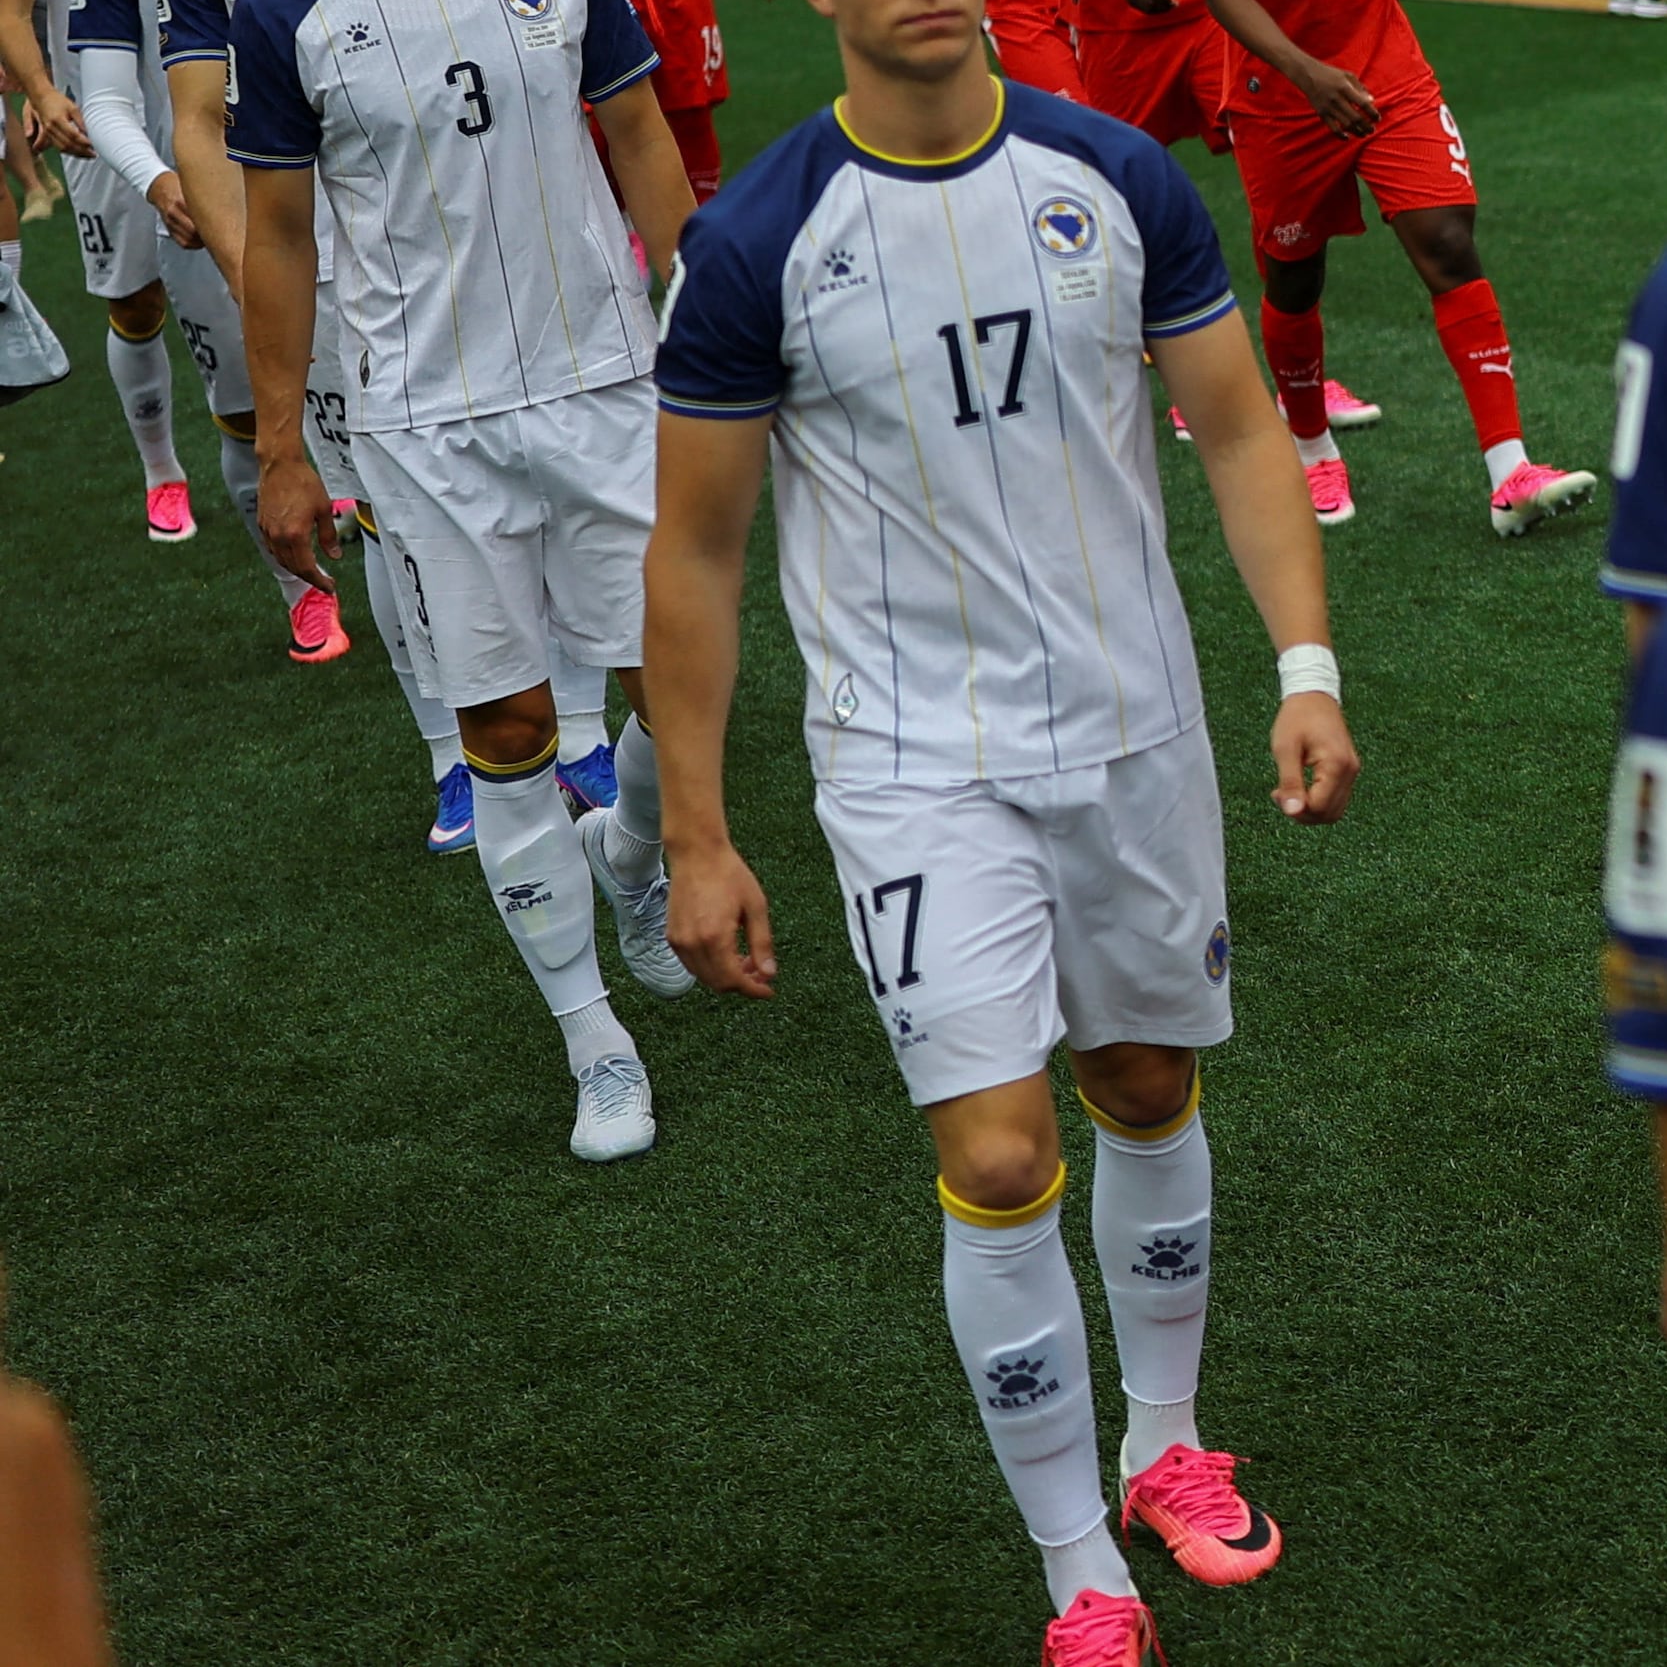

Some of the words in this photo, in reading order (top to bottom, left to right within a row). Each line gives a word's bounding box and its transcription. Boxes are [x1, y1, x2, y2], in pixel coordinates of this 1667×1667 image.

[343, 38, 383, 55] KELME
[701, 24, 723, 72] 19
[445, 60, 496, 138] 3
[1436, 102, 1464, 162] 9
[79, 213, 114, 253] 21
[817, 275, 869, 294] KELME
[938, 309, 1032, 430] 17
[504, 891, 553, 914] KELME
[855, 873, 932, 1000] 17
[1131, 1263, 1201, 1281] KELME
[987, 1378, 1060, 1410] KELME
